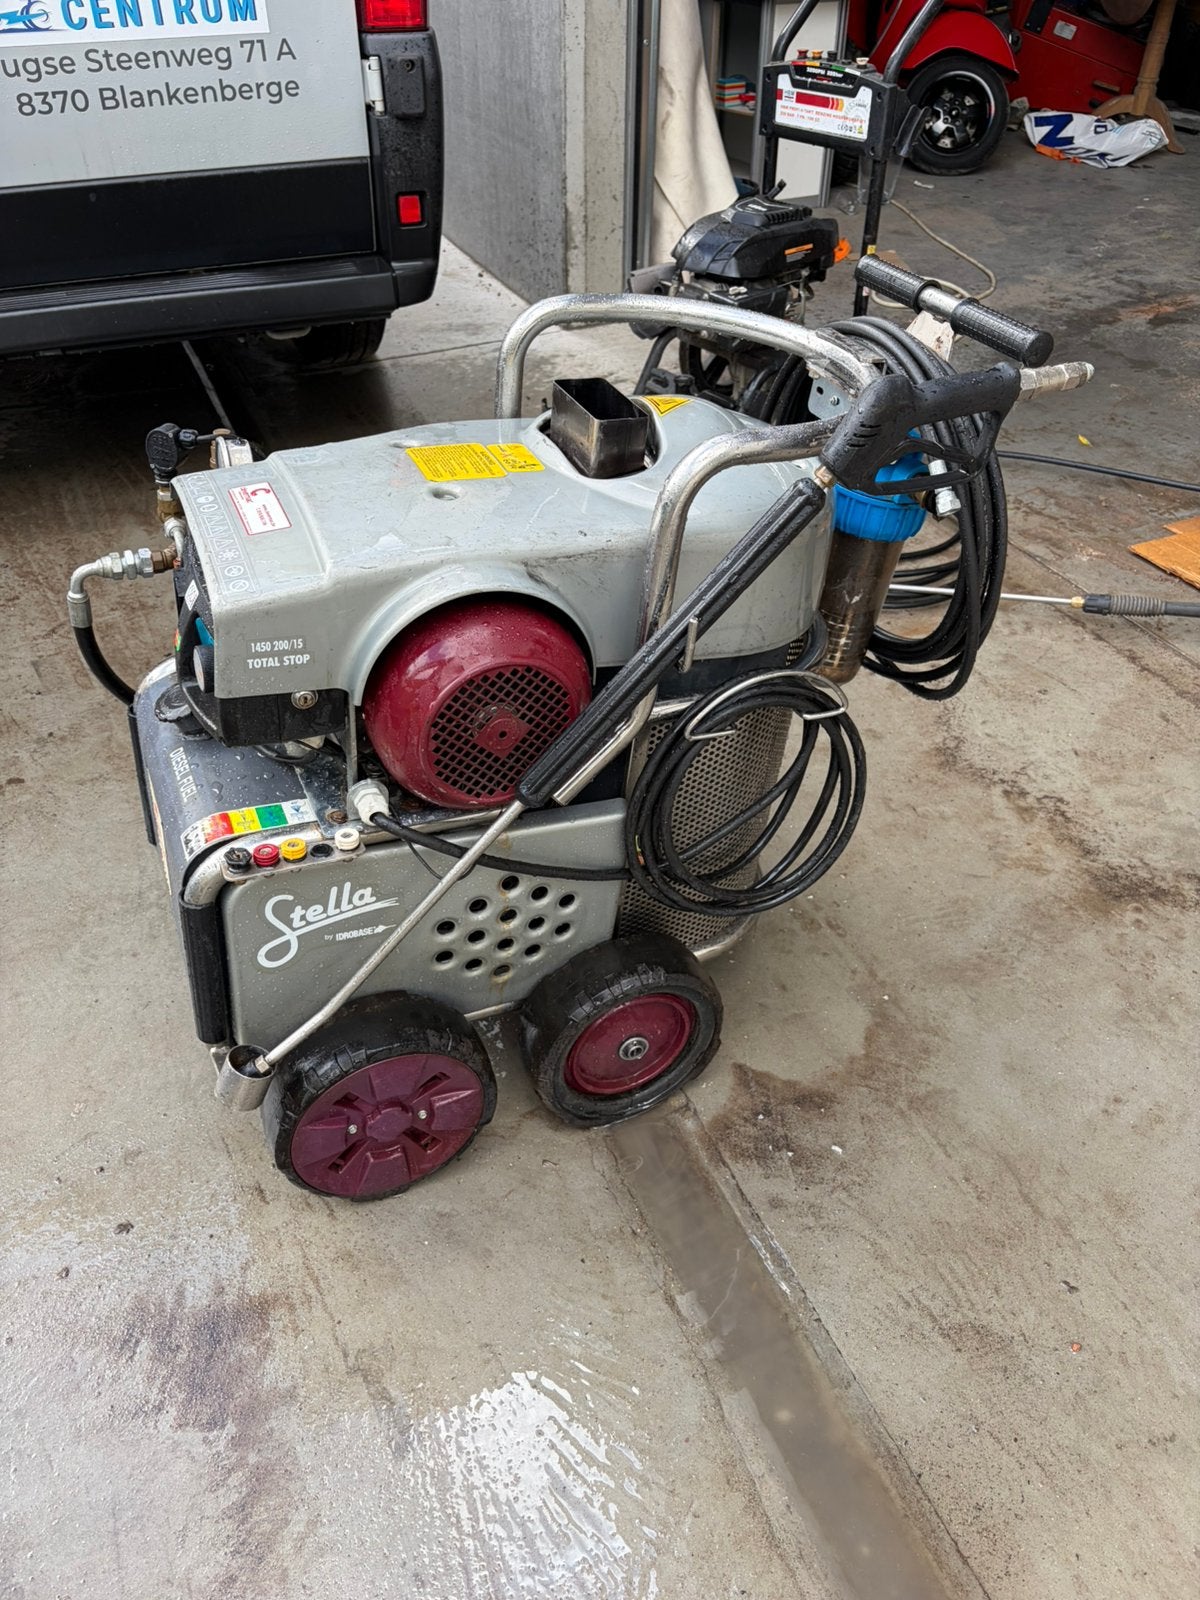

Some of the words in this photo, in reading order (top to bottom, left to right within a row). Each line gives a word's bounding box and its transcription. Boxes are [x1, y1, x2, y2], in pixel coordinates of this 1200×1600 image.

[84, 45, 232, 73] Steenweg
[239, 39, 267, 63] 71
[276, 38, 297, 61] A
[16, 89, 89, 116] 8370
[99, 78, 300, 111] Blankenberge
[246, 656, 281, 669] TOTAL
[283, 653, 311, 666] STOP
[251, 641, 272, 653] 1450
[273, 638, 304, 651] 200/15
[169, 746, 190, 781] DIESEL
[178, 775, 198, 803] FUEL
[257, 881, 388, 968] Stella
[336, 927, 374, 941] IDROBASE
